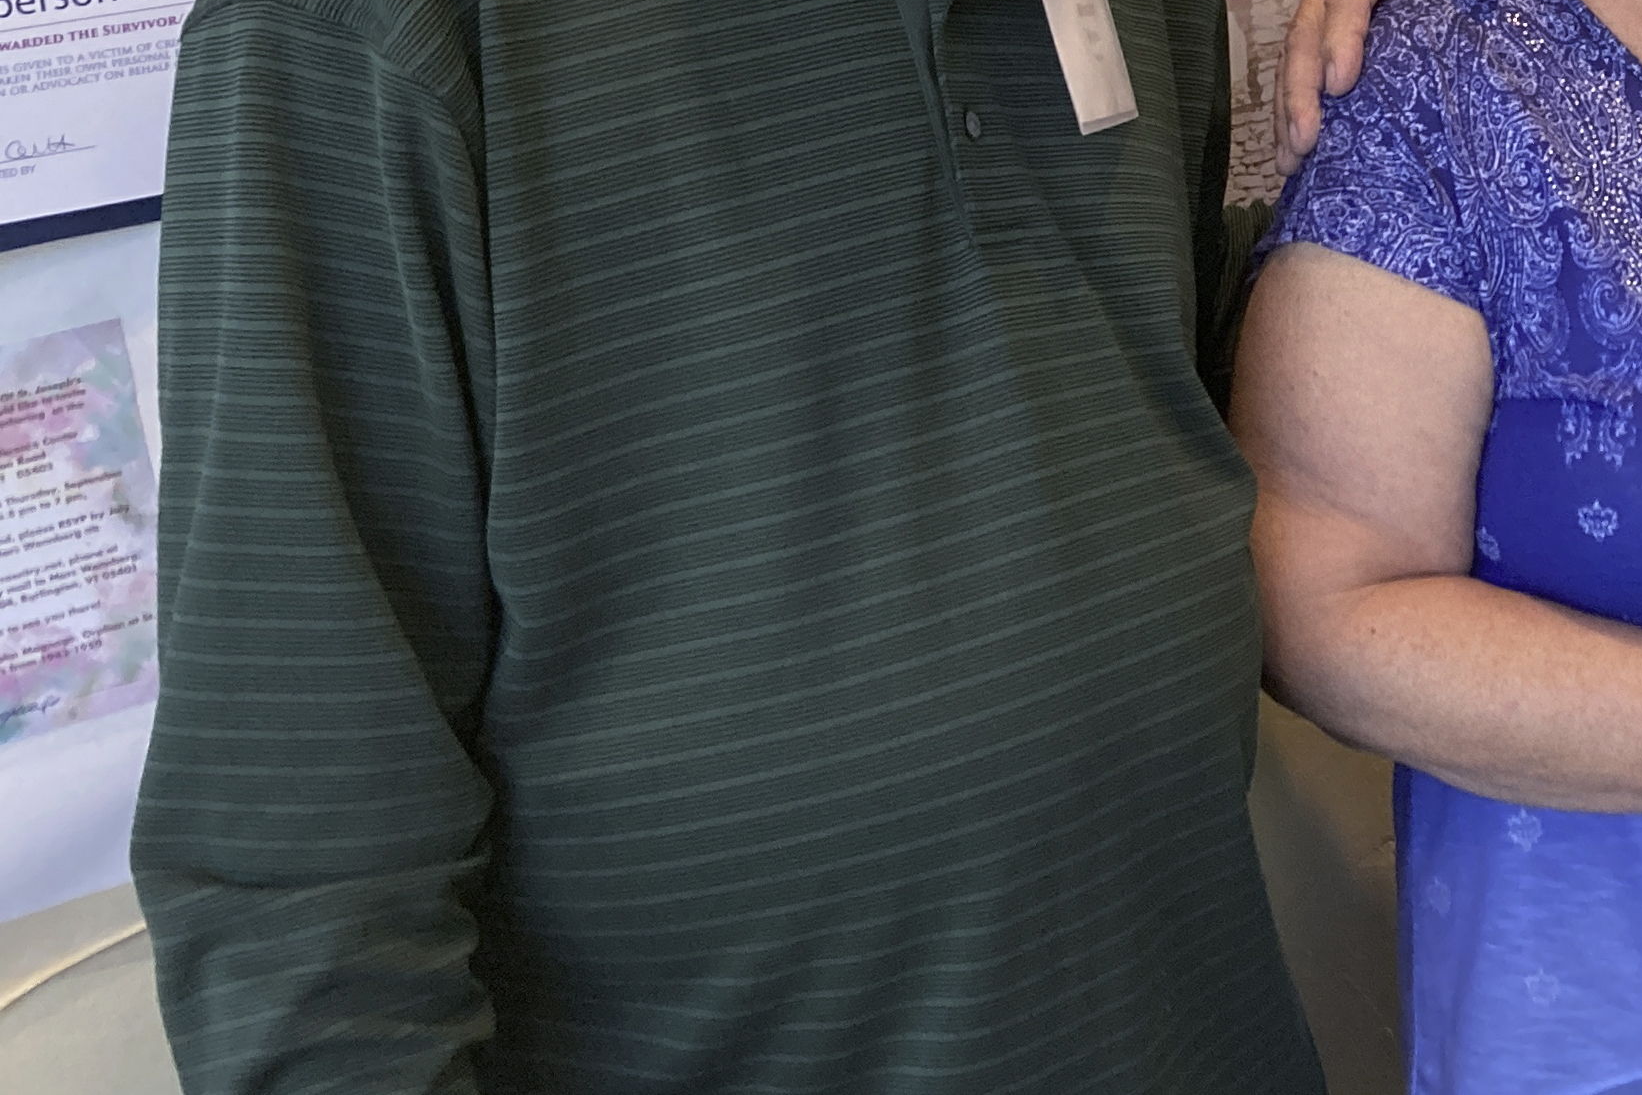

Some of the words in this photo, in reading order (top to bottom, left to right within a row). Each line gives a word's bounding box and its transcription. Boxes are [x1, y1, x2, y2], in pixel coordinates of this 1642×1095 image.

[68, 28, 98, 41] THE
[13, 60, 52, 72] GIVEN
[56, 55, 74, 65] TO
[77, 53, 85, 62] A
[89, 47, 132, 60] VICTIM
[136, 42, 153, 53] OF
[36, 67, 70, 79] THEIR
[75, 61, 107, 73] OWN
[111, 52, 171, 67] PERSONAL
[10, 86, 28, 96] OR
[32, 73, 100, 92] ADVOCACY
[104, 71, 124, 80] ON
[128, 62, 171, 76] BEHALF
